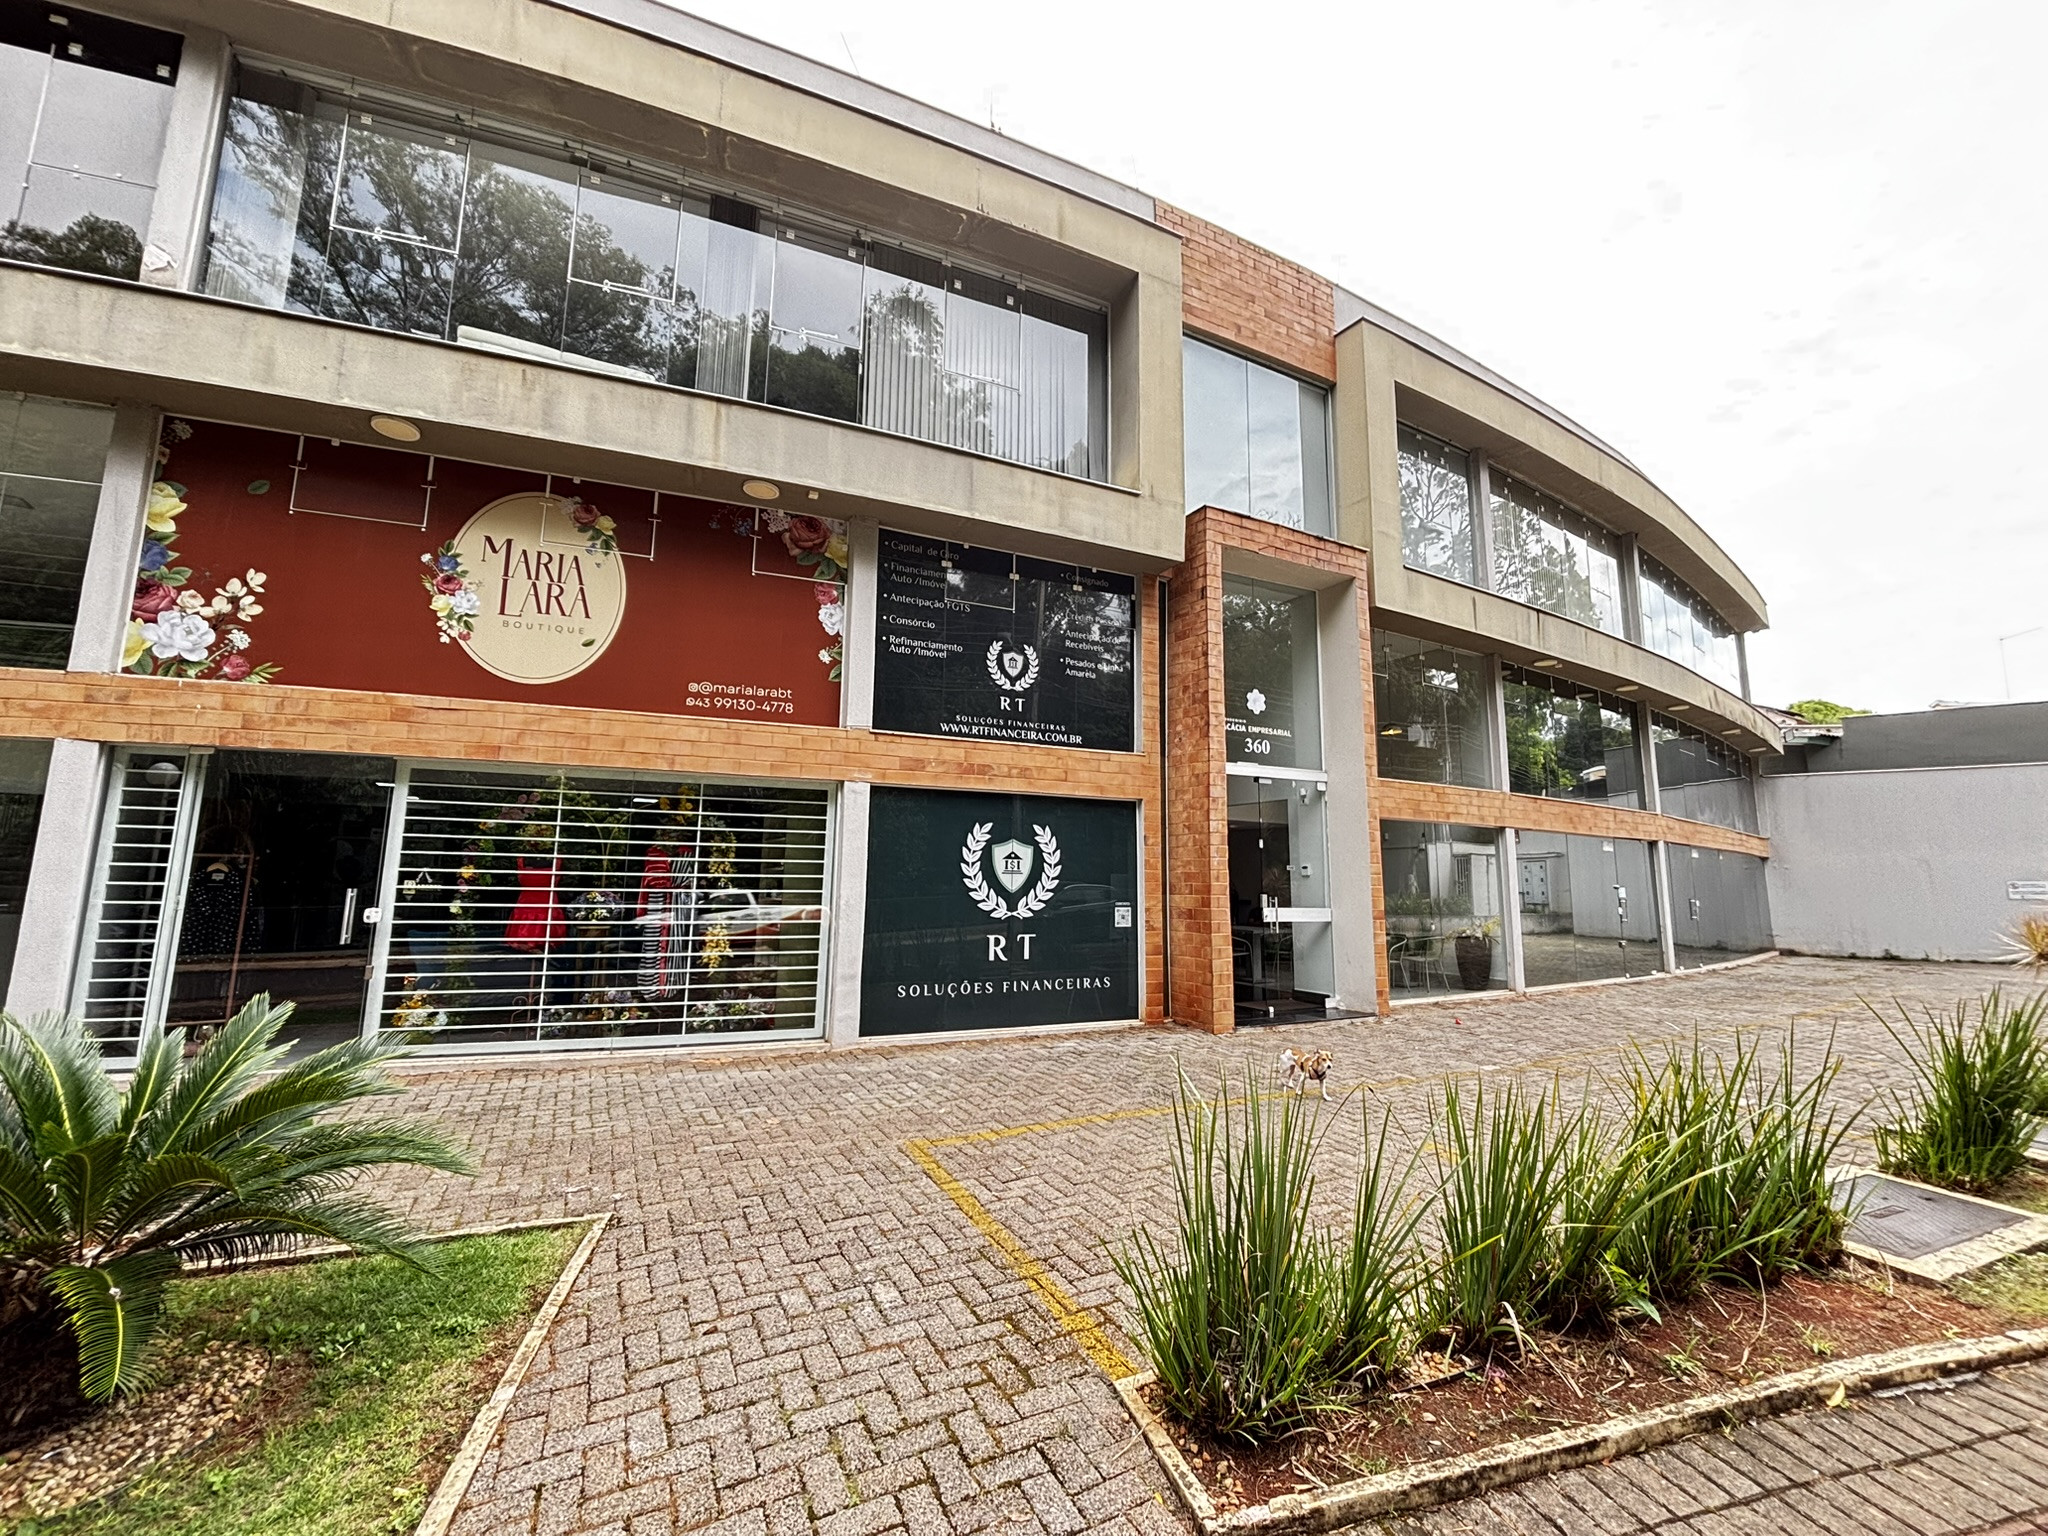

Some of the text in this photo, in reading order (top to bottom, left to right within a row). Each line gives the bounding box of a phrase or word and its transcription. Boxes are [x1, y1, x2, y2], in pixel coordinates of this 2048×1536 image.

[891, 541, 960, 560] Capital de Giro
[481, 535, 585, 586] MARIA
[890, 562, 954, 580] Financiamen
[890, 573, 912, 584] Auto
[498, 578, 591, 619] LARA
[889, 593, 971, 613] Antecipação FGTS
[502, 620, 585, 635] BOUTIQUE
[889, 614, 936, 629] Consórcio
[889, 634, 964, 652] Refinanciamento
[889, 644, 911, 655] Auto
[1065, 640, 1105, 652] Recebíveis
[1065, 657, 1096, 669] Pesados
[695, 697, 794, 714] 43 99130-4778
[955, 714, 1066, 732] SOLUÇÕES FINANCEIRAS
[1248, 725, 1292, 738] EMPRESARIAL
[940, 722, 1083, 744] WWW.RTFINANCEIRA.COM.BR
[1244, 738, 1271, 755] 360
[897, 976, 1112, 998] SOLUÇÕES FINANCEIRAS
